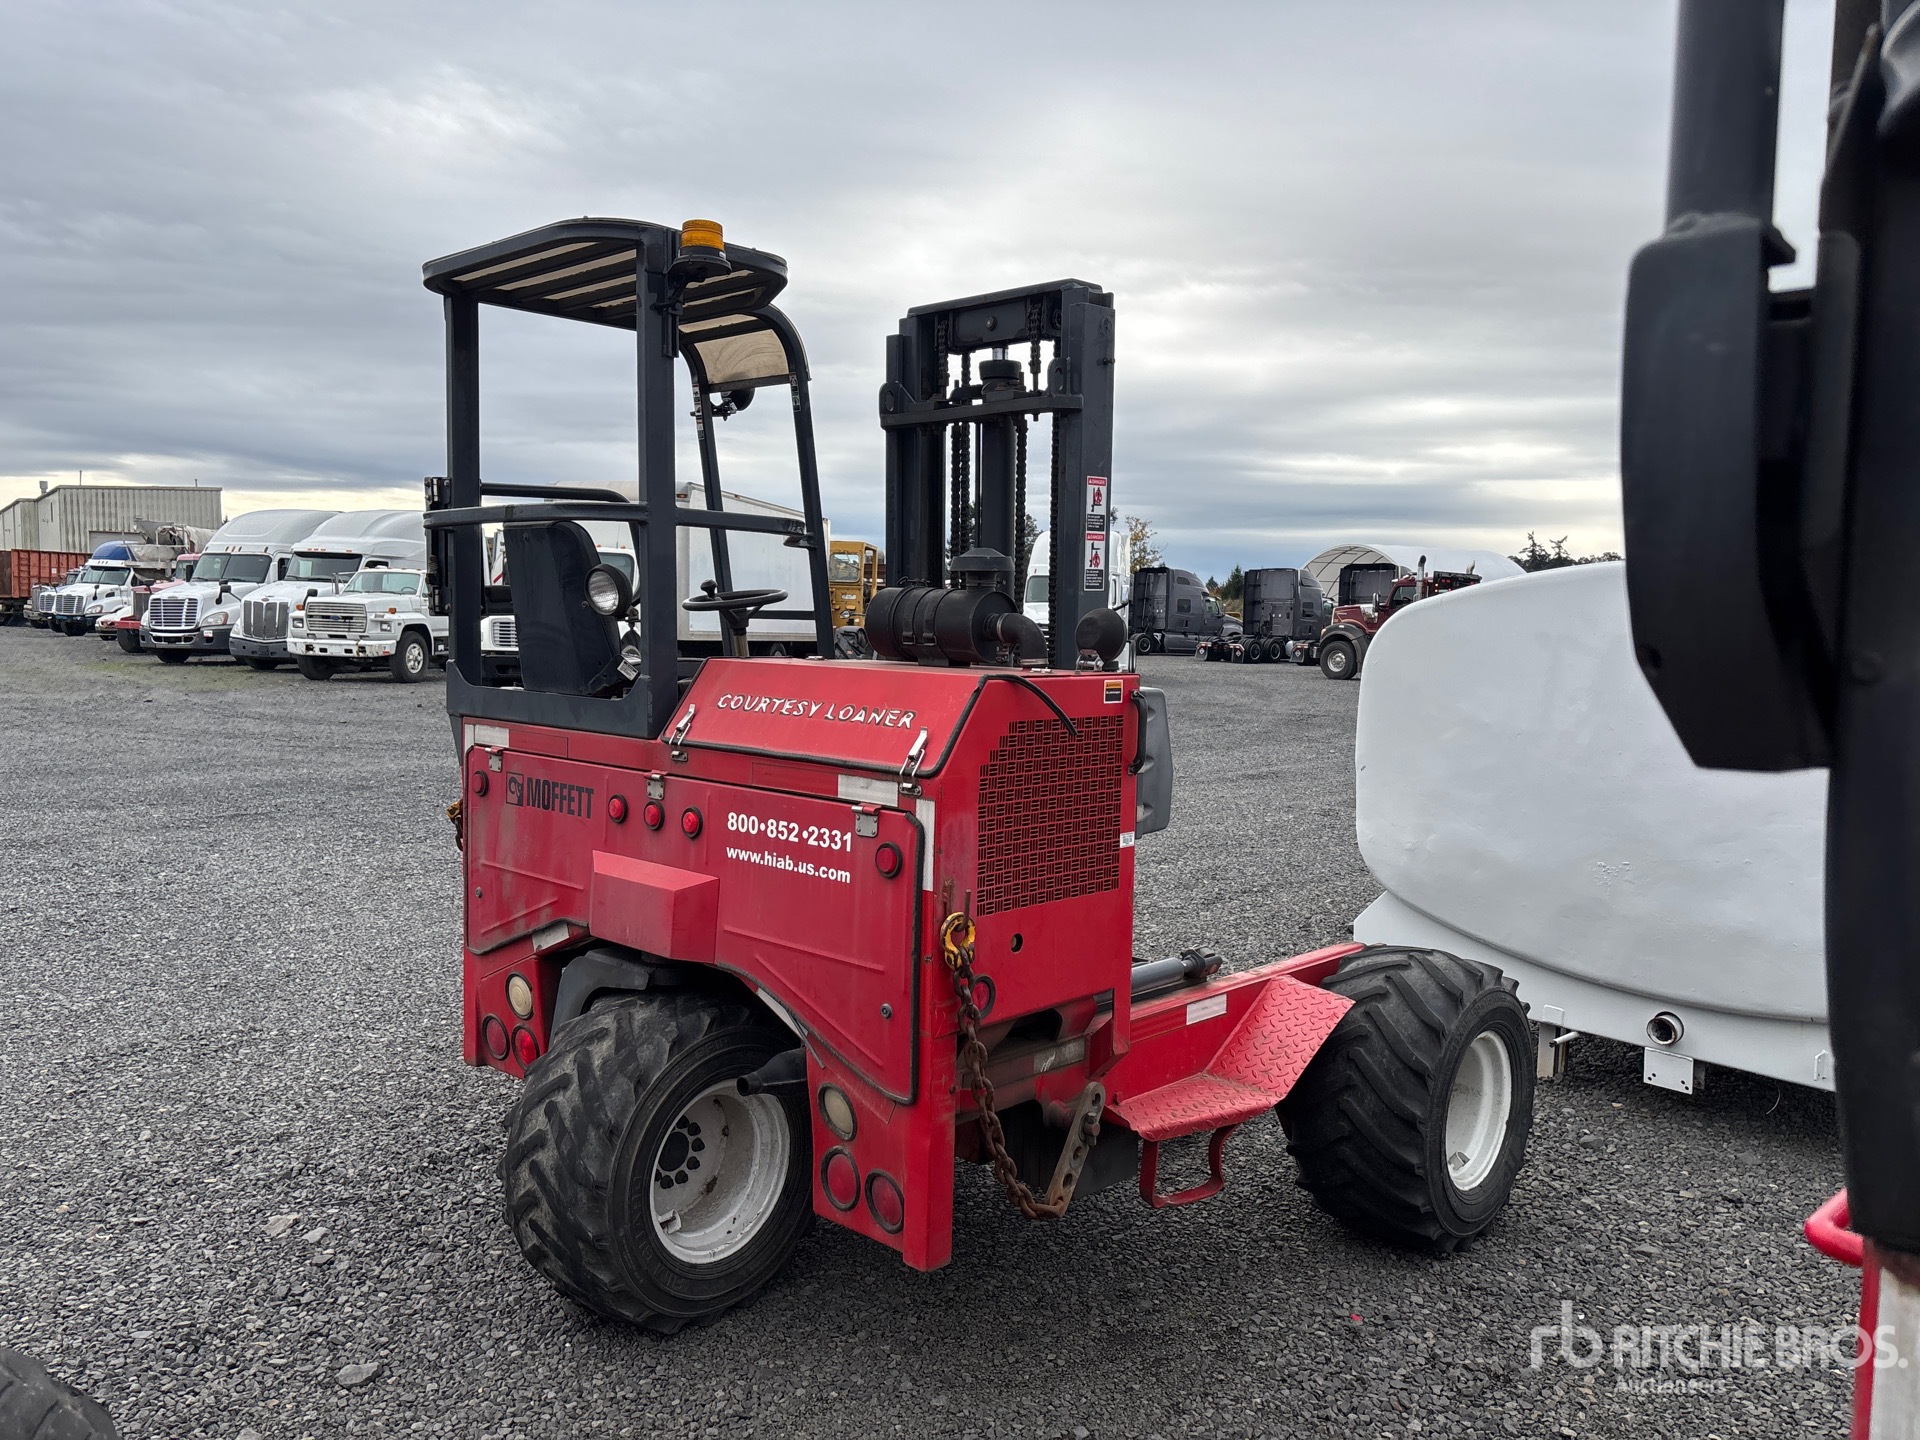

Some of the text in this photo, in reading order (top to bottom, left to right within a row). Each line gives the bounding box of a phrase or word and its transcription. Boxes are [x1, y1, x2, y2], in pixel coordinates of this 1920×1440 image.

[717, 693, 916, 729] COURTESY LOANER
[527, 777, 594, 819] MOFFETT
[726, 846, 851, 884] www.hiab.us.com
